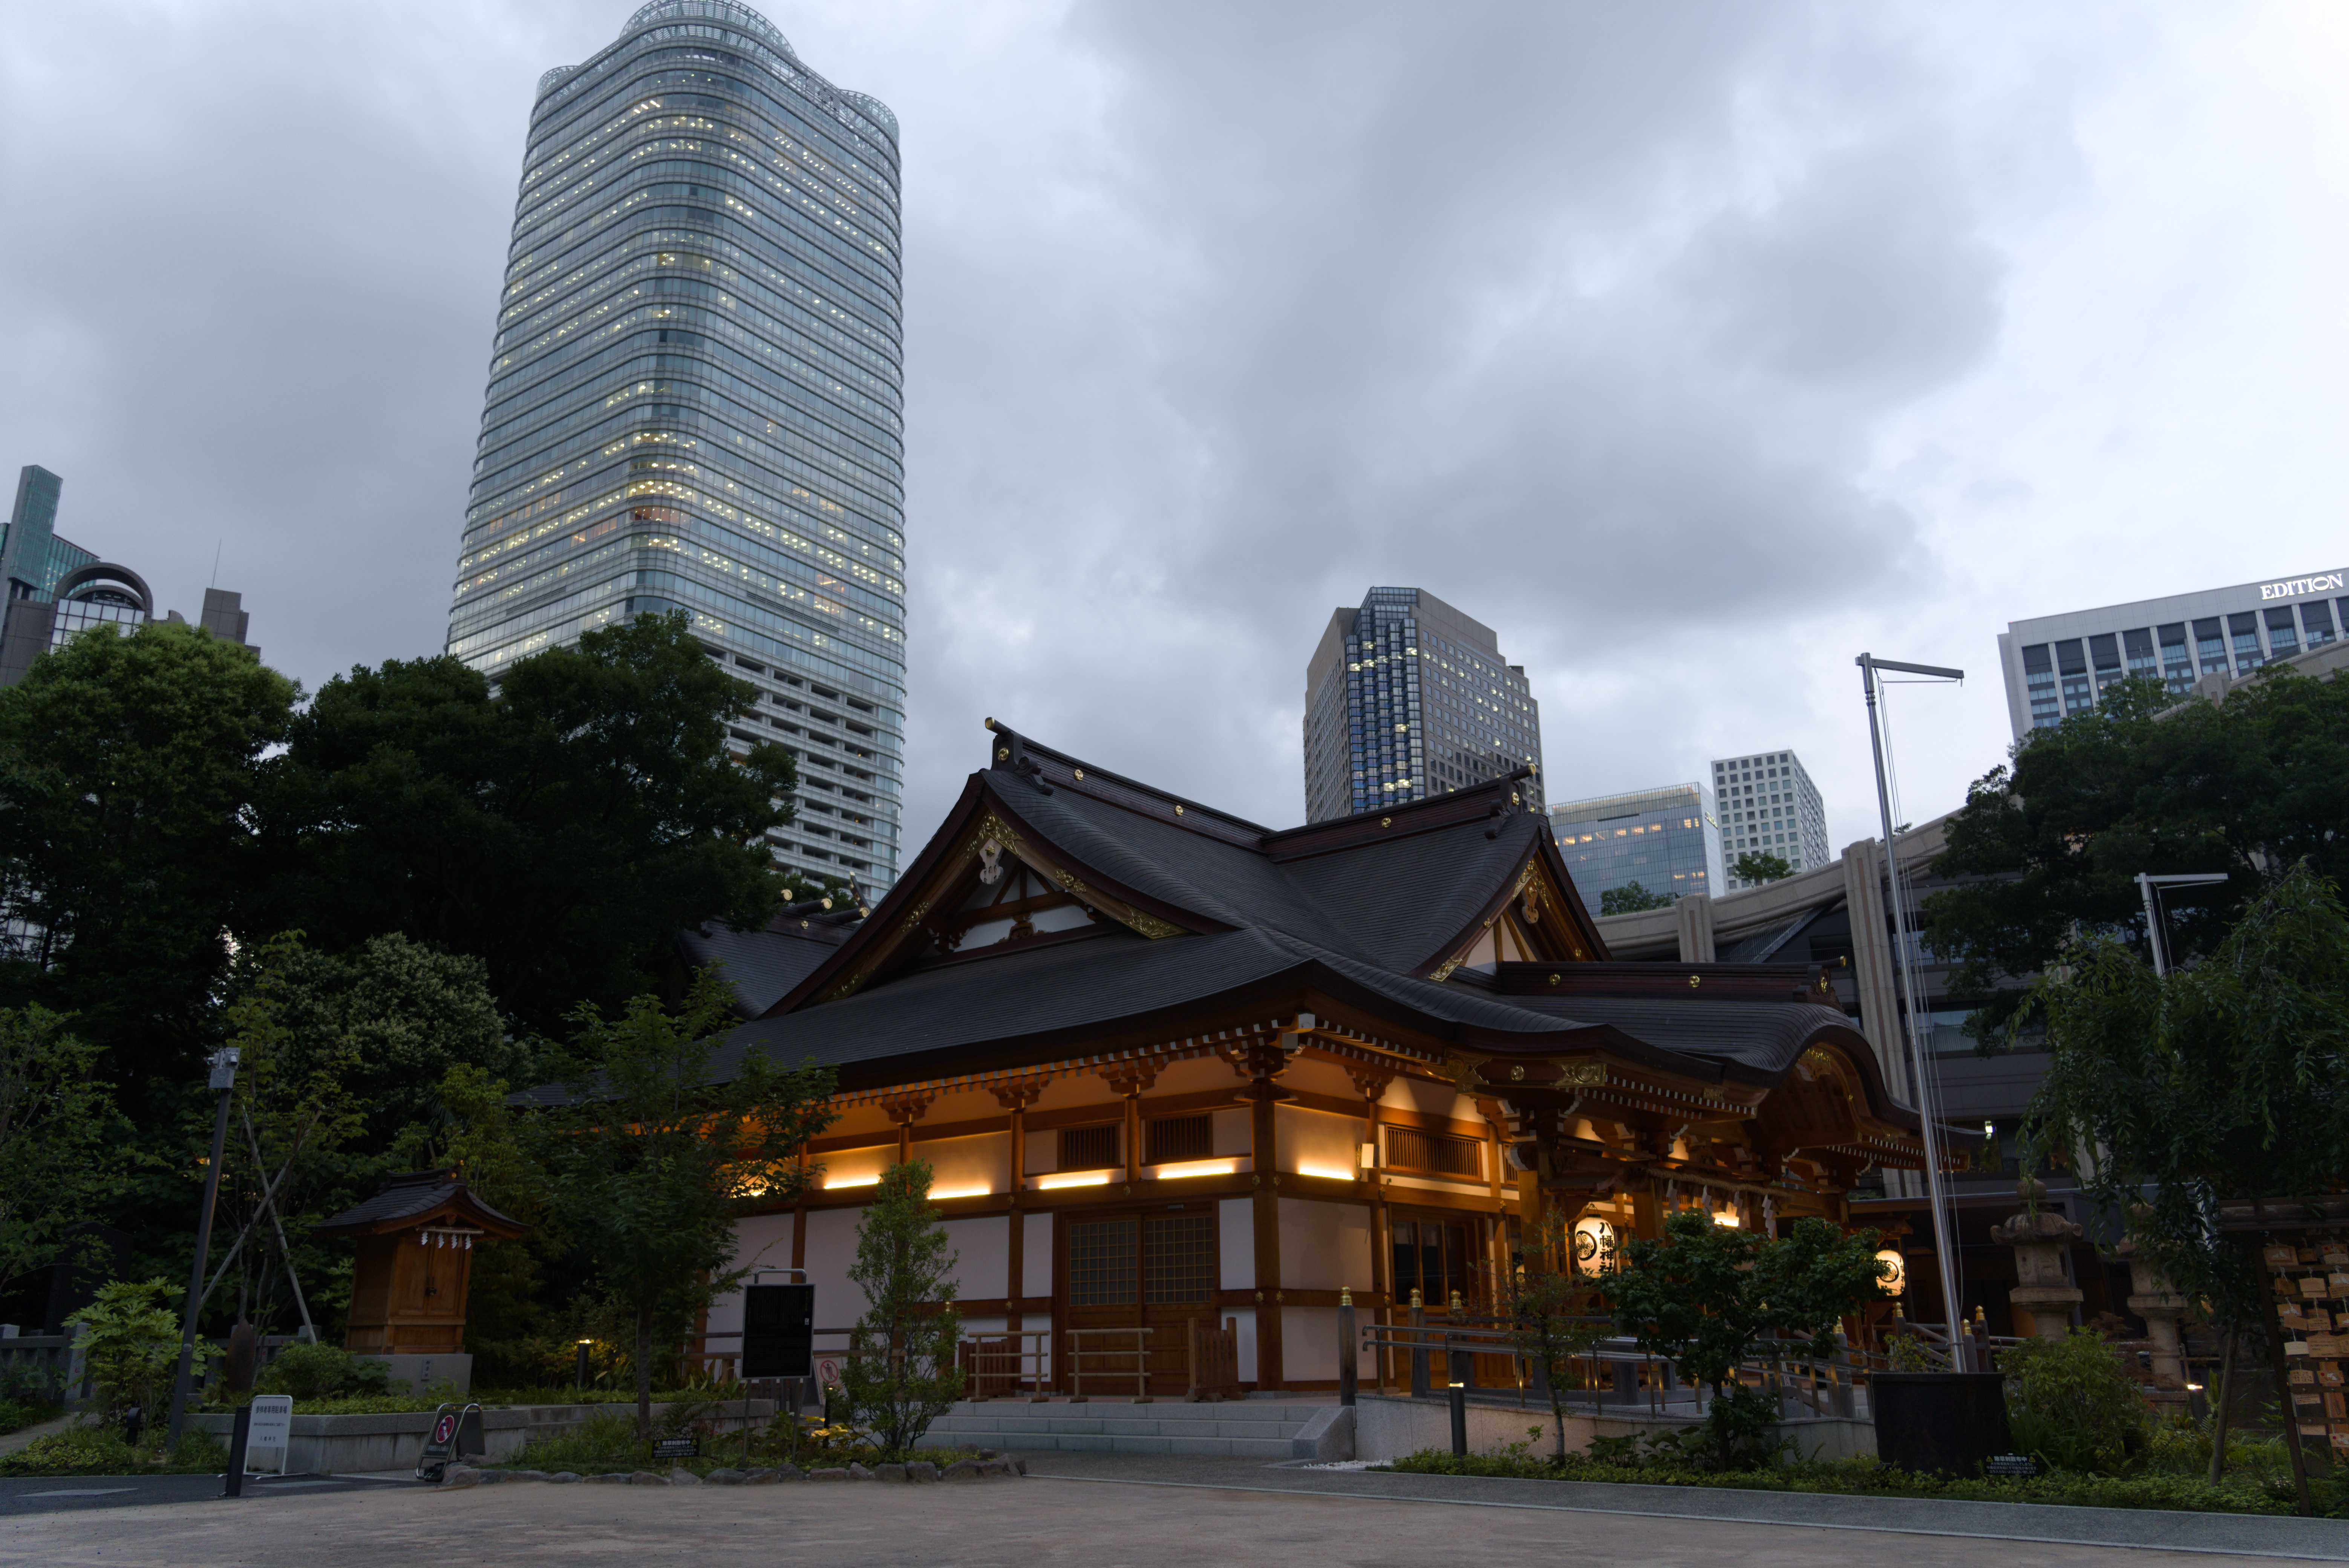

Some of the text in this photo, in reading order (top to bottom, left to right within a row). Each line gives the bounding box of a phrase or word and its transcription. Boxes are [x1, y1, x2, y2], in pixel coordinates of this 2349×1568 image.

[2260, 573, 2343, 600] EDITION
[1599, 1222, 1614, 1273] 八幡神社
